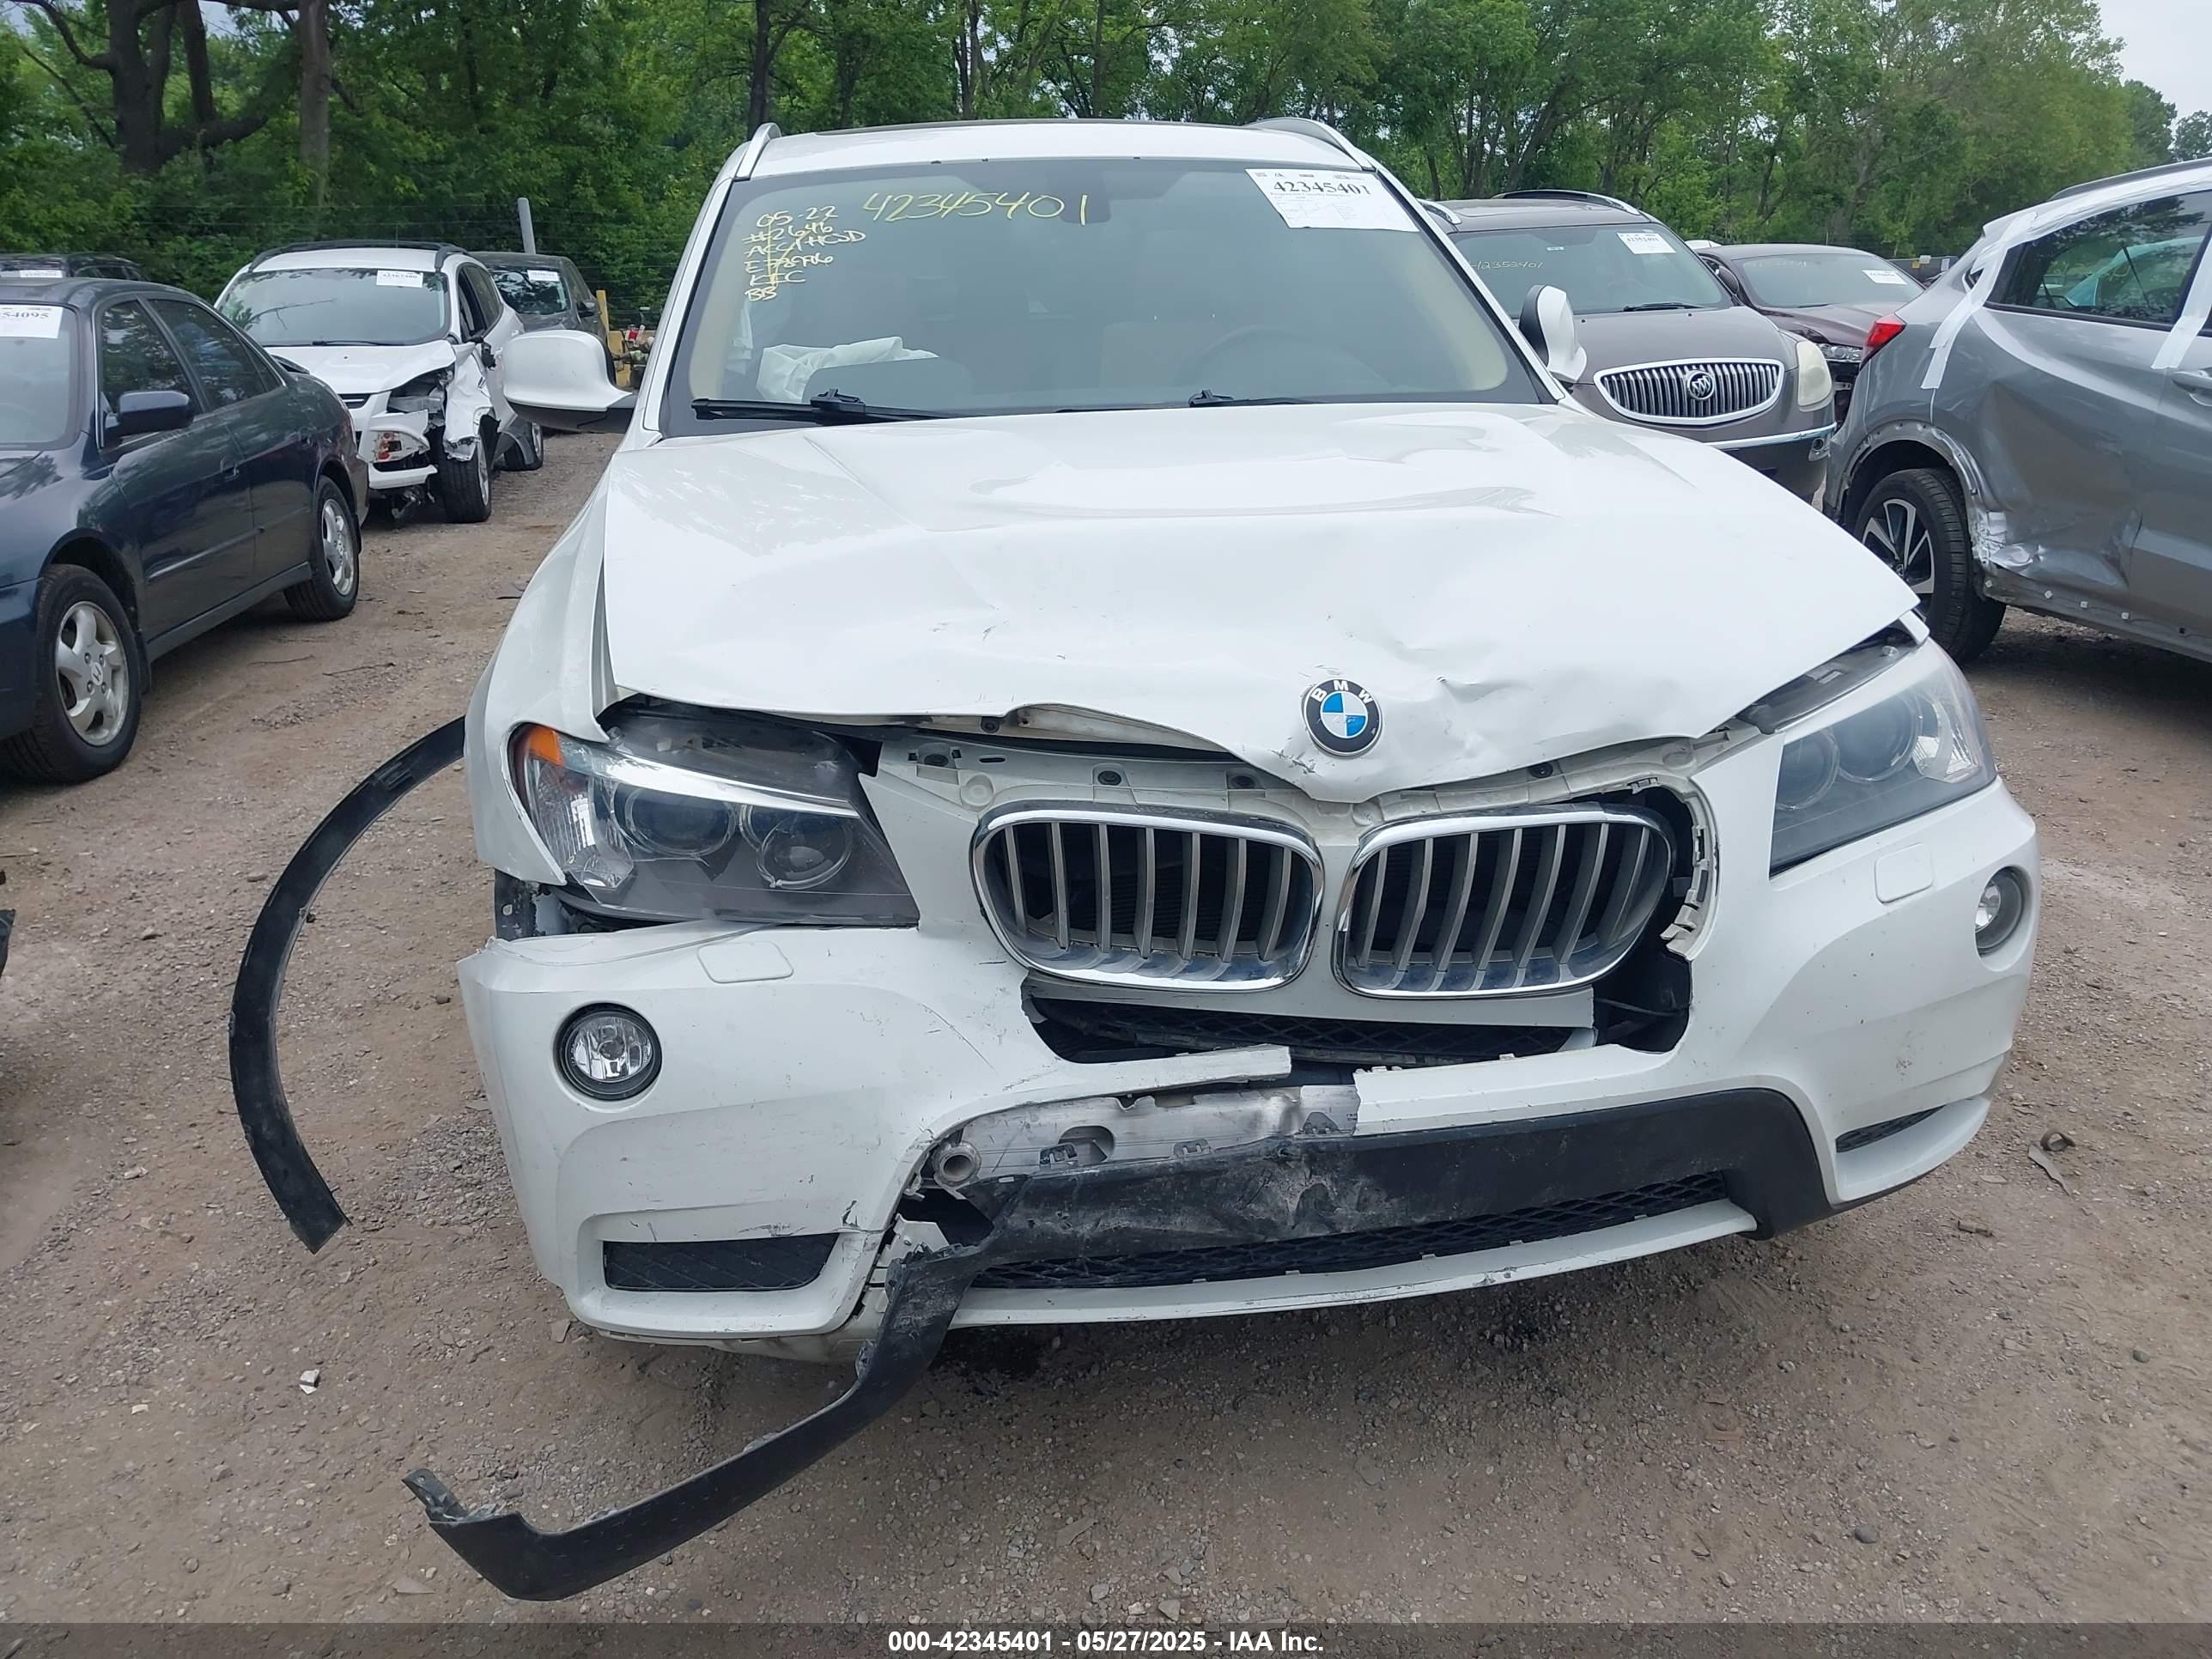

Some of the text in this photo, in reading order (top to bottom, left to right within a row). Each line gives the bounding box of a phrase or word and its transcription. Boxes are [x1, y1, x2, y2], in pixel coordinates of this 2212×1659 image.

[1273, 181, 1371, 195] 42345401
[863, 191, 1089, 227] 42345401
[0, 311, 49, 319] 54095
[1310, 679, 1373, 704] BMW
